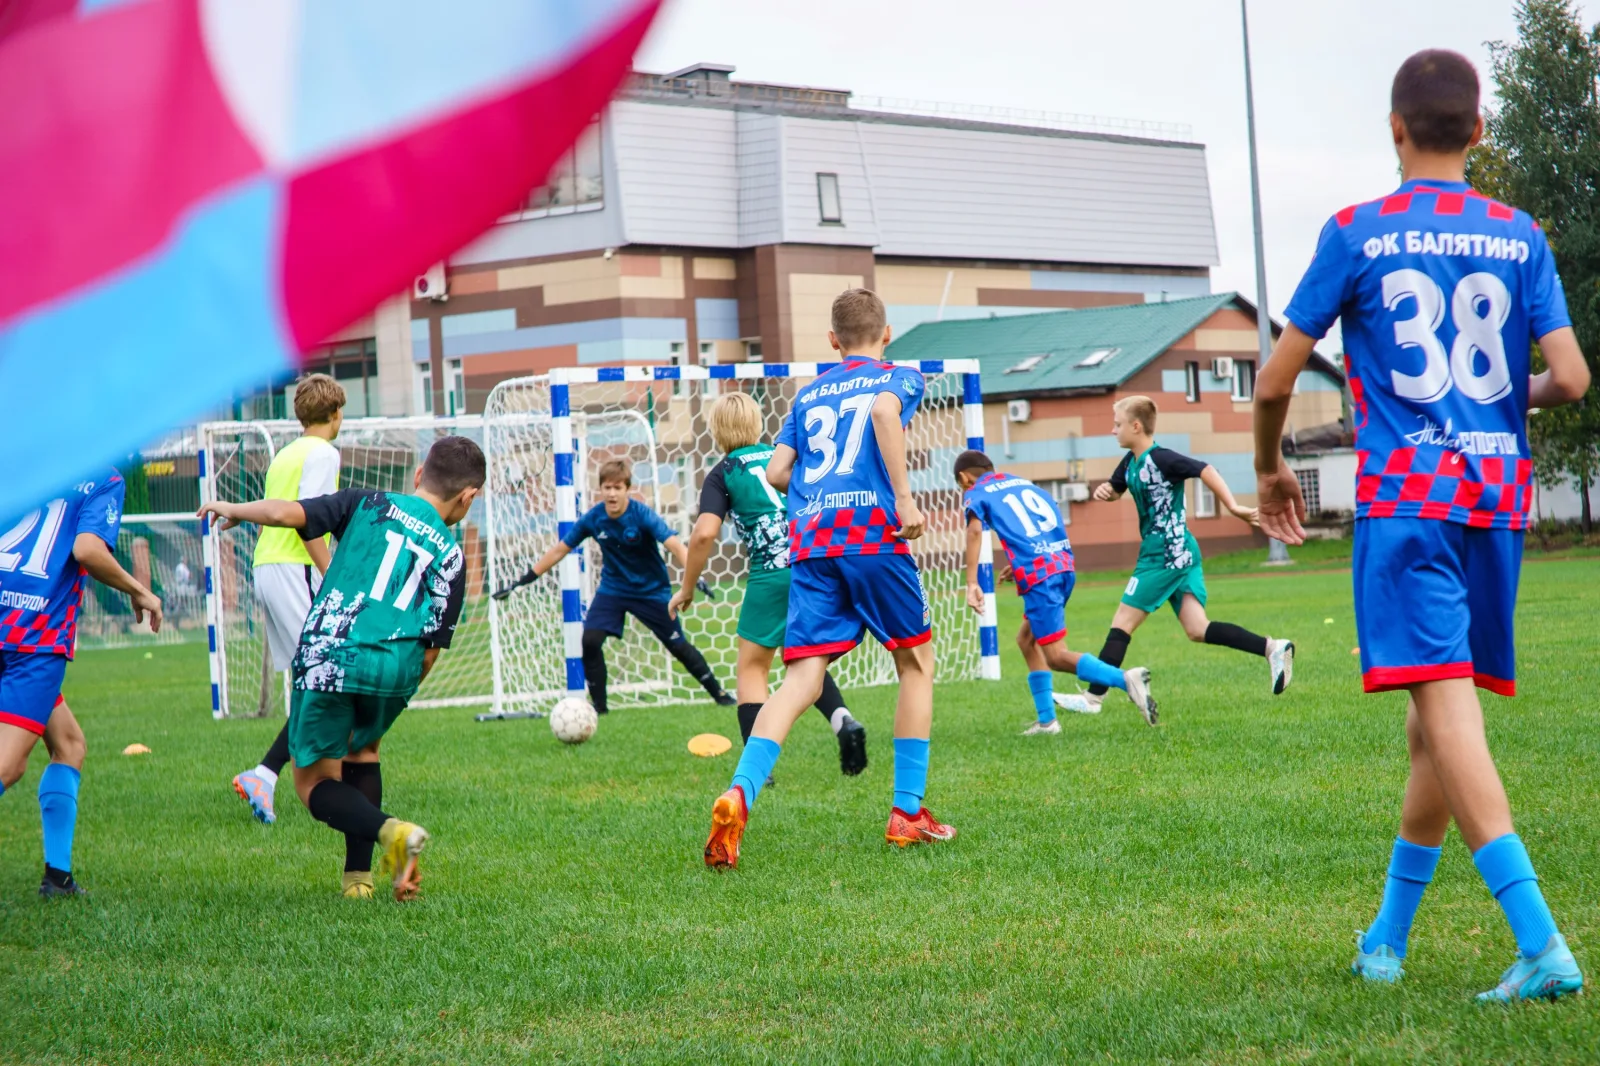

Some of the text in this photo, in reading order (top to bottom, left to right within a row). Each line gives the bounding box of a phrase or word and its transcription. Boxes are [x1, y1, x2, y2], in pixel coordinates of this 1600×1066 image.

[1363, 232, 1400, 259] ФК
[1381, 267, 1513, 405] 38
[801, 373, 892, 404] ФК БАЛЯТИНО
[804, 393, 877, 484] 37
[748, 465, 787, 509] 1
[824, 490, 878, 508] СПОРТОМ
[386, 503, 451, 554] ЛЮБЕРЦЫ
[1002, 489, 1058, 537] 19
[369, 529, 435, 612] 17
[0, 590, 49, 612] СПОРТОМ
